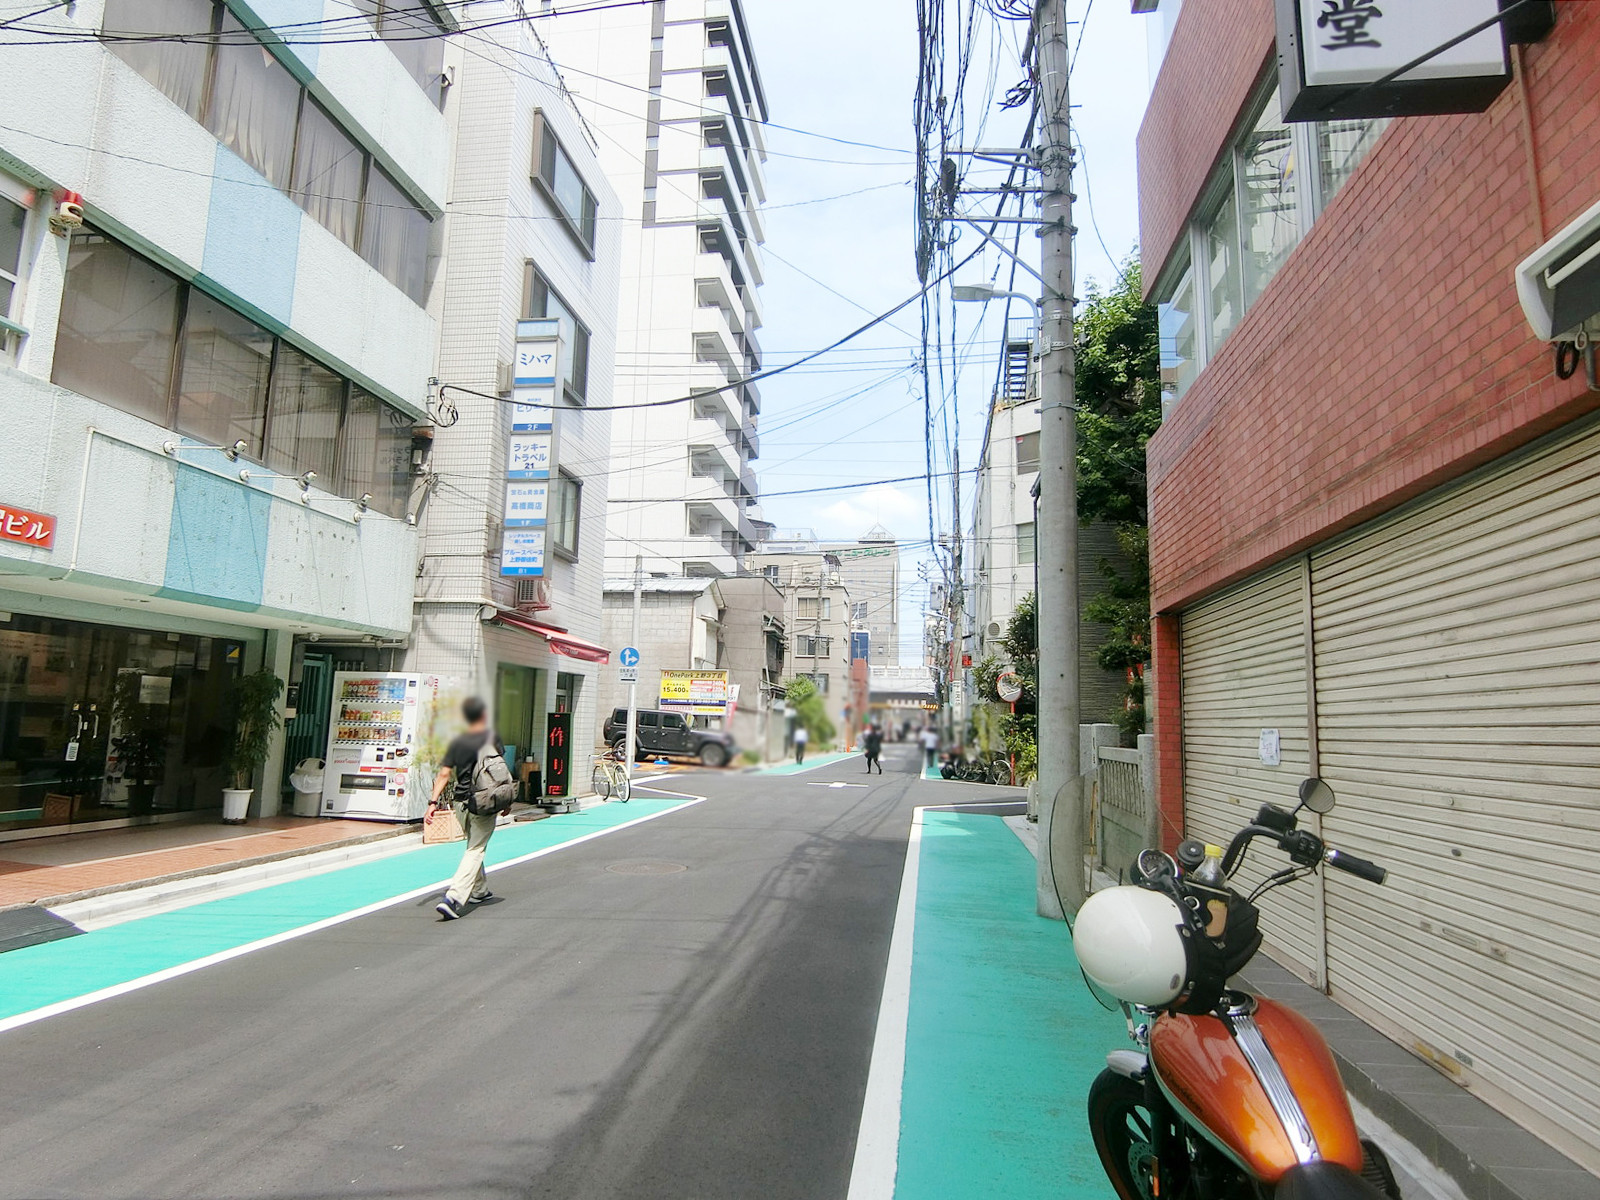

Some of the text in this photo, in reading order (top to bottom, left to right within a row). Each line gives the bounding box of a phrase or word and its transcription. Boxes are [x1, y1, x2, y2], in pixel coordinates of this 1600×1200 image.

[1317, 0, 1383, 51] 堂
[520, 353, 552, 365] ミハマ
[514, 443, 547, 451] ラッキー
[514, 452, 547, 463] トラベル
[524, 462, 535, 470] 21
